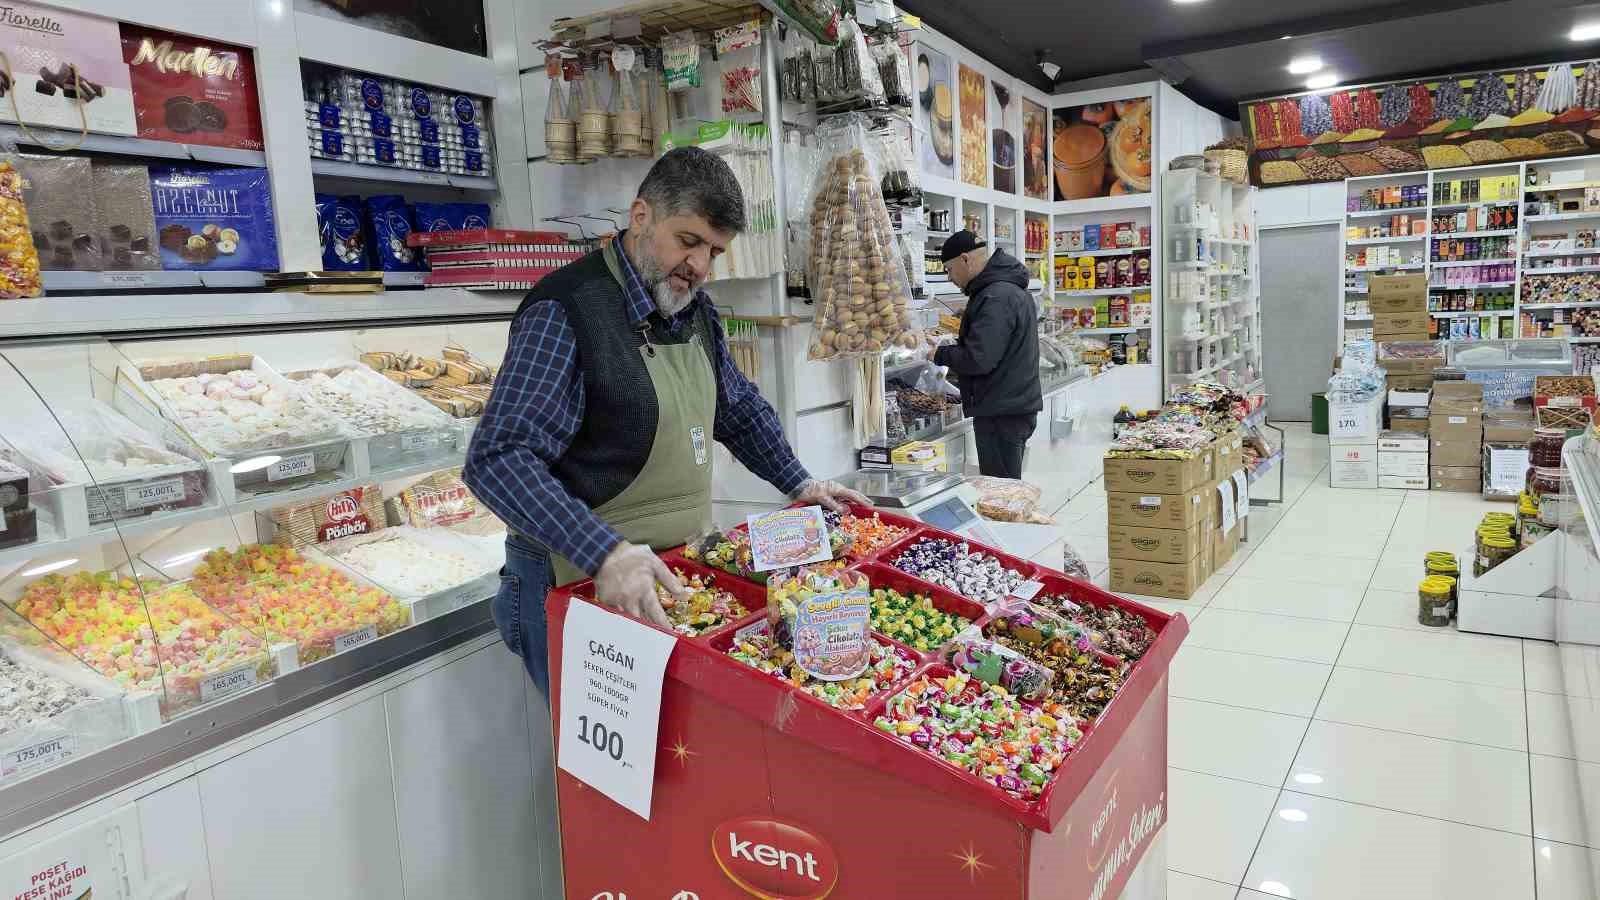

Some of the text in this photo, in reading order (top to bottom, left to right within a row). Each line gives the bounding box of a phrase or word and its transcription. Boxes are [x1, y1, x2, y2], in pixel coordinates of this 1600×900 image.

[132, 37, 238, 80] Madlen
[156, 188, 240, 214] AZELNUT
[589, 640, 634, 670] ÇAĞAN
[16, 741, 63, 763] 175,00TL
[729, 832, 820, 881] kent
[31, 860, 69, 886] POŞET
[48, 864, 87, 891] KAĞIDI
